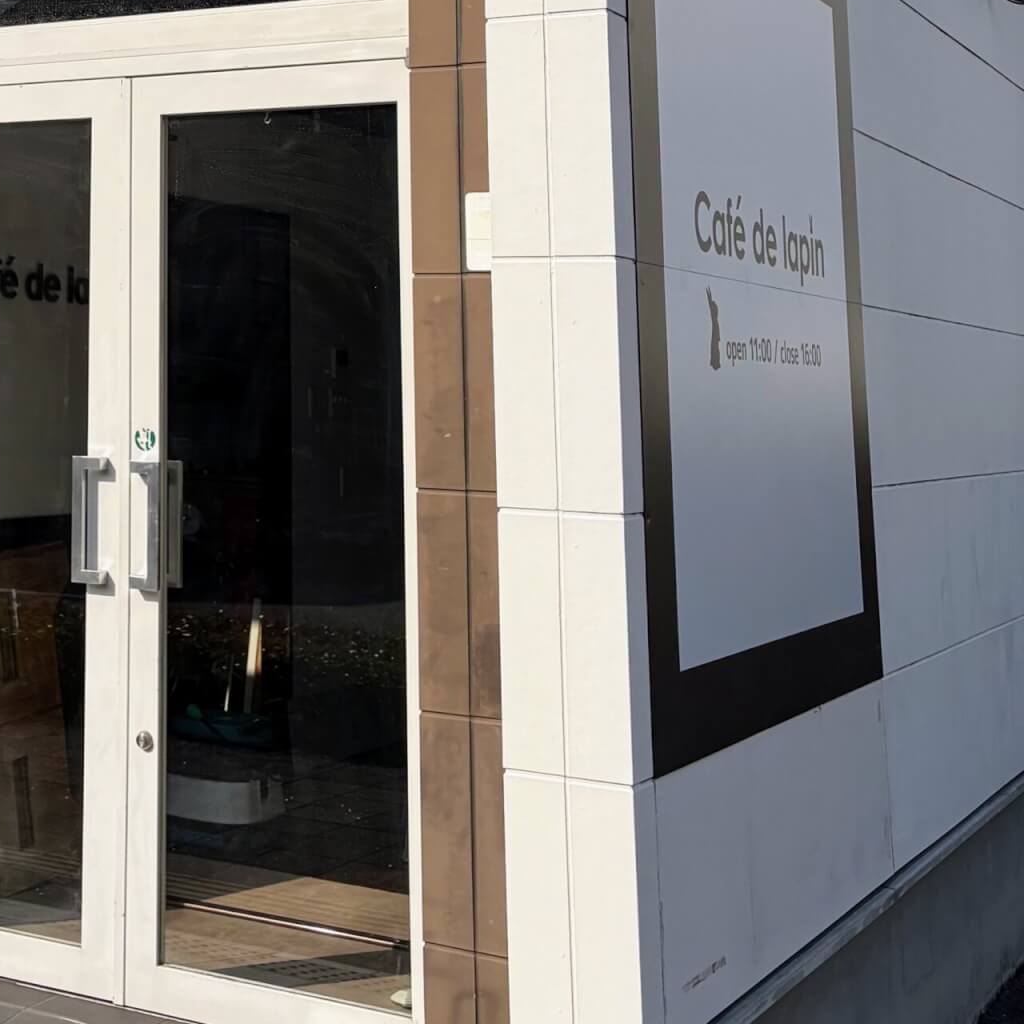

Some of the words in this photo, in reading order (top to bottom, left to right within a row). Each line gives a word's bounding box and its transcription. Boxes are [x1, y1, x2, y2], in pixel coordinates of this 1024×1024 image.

[694, 190, 746, 260] Café
[752, 208, 777, 267] de
[782, 215, 825, 287] lapin
[24, 261, 62, 303] de
[726, 340, 747, 367] open
[749, 337, 772, 363] 11:00
[780, 340, 799, 365] close
